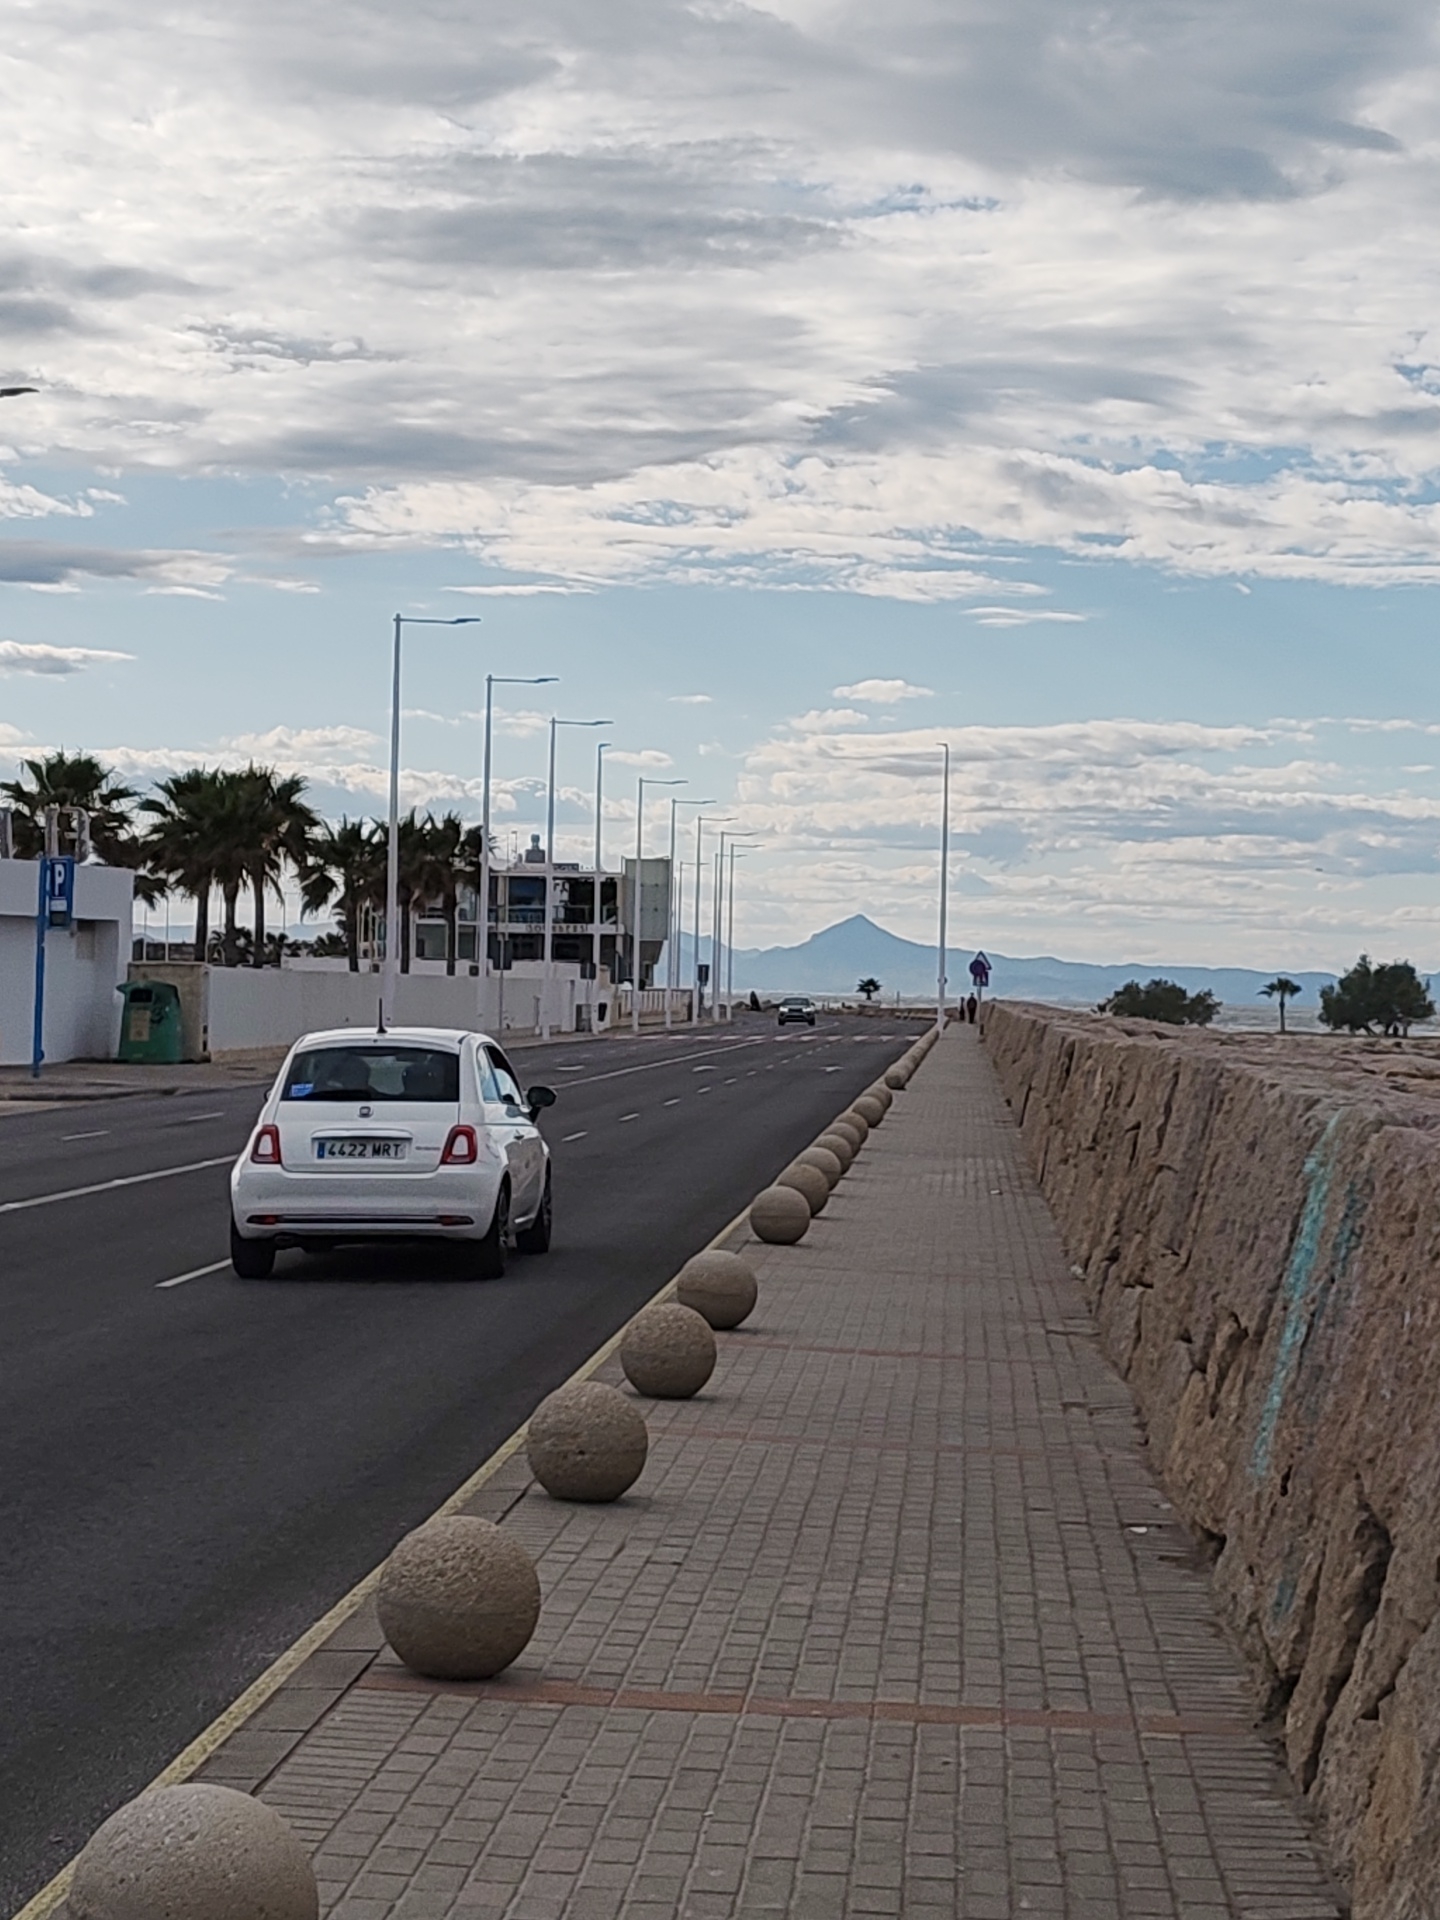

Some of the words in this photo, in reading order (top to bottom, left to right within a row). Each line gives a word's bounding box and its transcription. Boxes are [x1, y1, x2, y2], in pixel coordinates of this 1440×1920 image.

[54, 863, 65, 896] P
[327, 1143, 367, 1157] 4422
[371, 1143, 401, 1157] MRT
